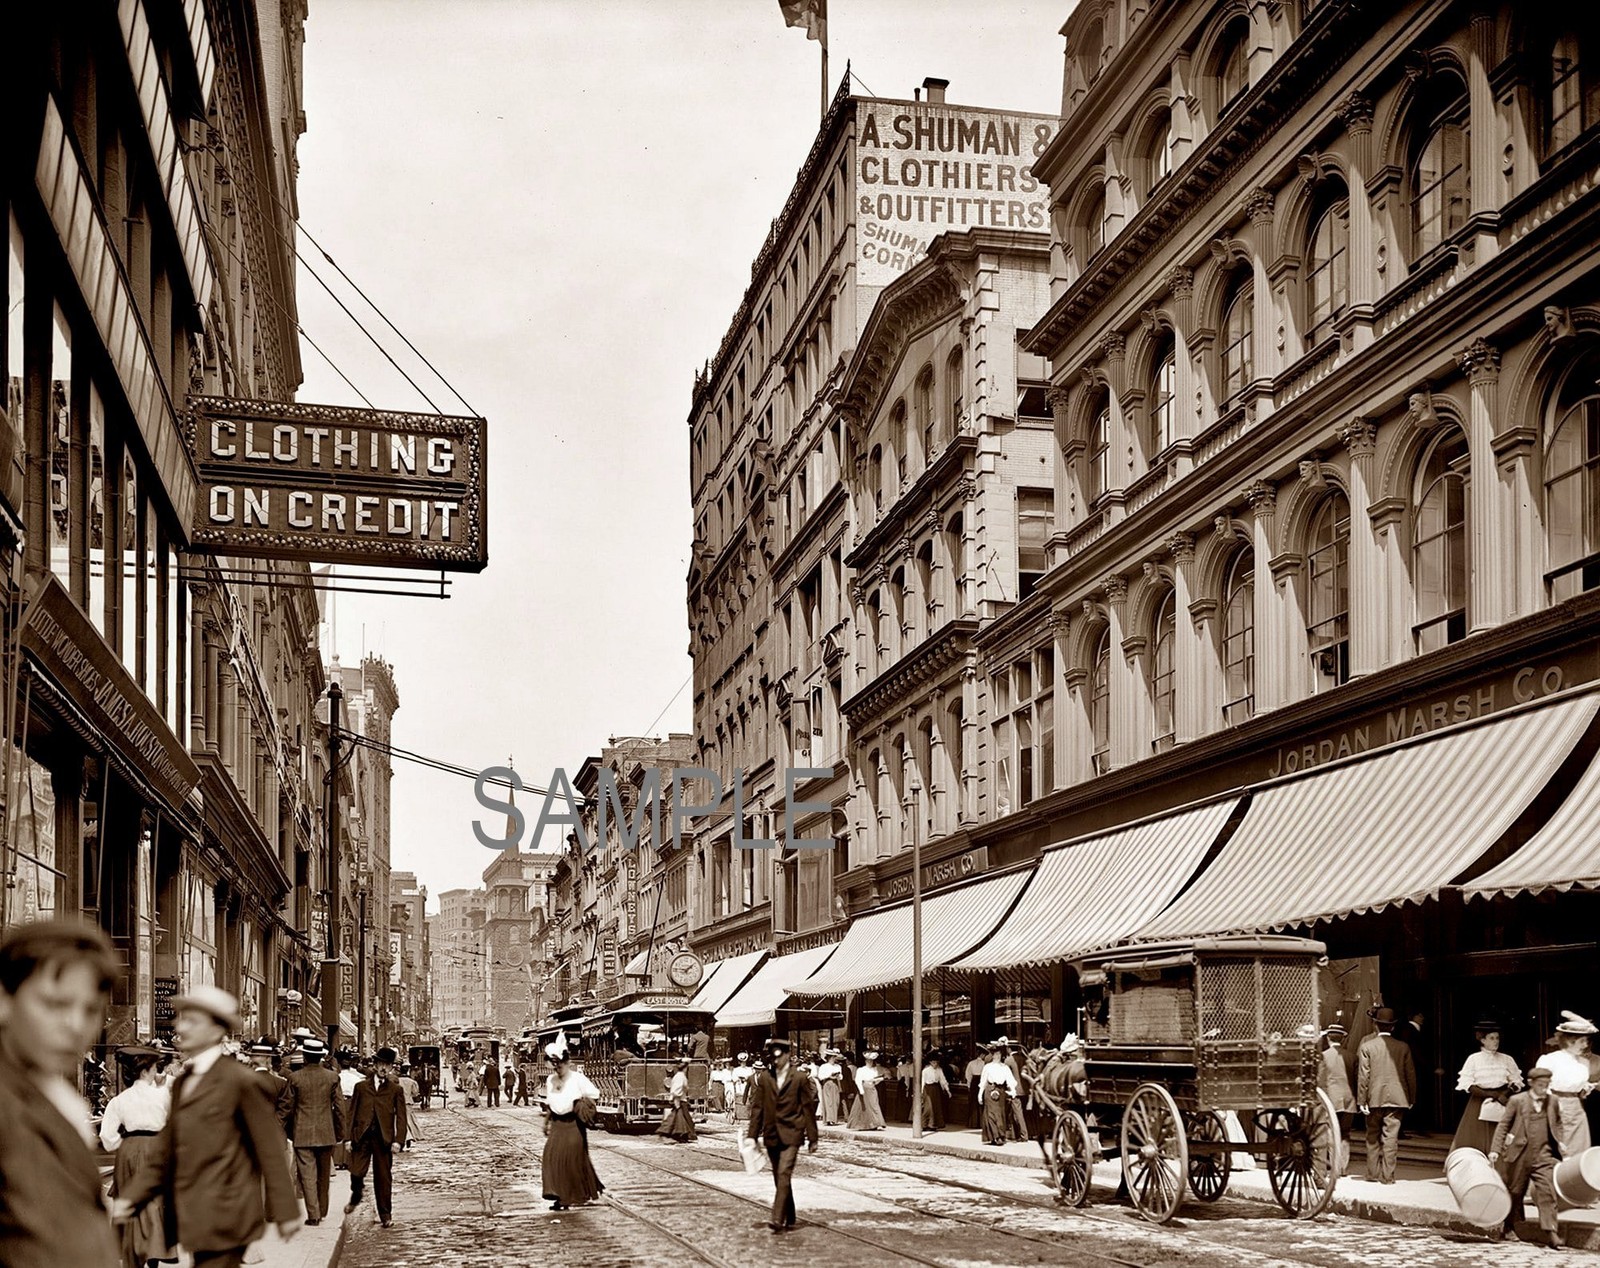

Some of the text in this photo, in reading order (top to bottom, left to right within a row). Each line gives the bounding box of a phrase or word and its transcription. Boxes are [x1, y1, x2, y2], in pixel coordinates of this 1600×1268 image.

[861, 156, 1038, 193] CLOTHIERS
[210, 420, 455, 474] CLOTHING
[209, 485, 458, 538] ON CREDIT
[28, 605, 59, 643] LITTLE
[51, 628, 83, 672] WONDER
[75, 658, 102, 692] SHOES
[94, 677, 133, 727] JAMES
[129, 719, 169, 770] HOUSTON
[1268, 725, 1370, 779] JORDAN
[1385, 684, 1496, 742] MARSH
[887, 875, 915, 898] JORDA
[925, 860, 957, 888] MARSH
[343, 926, 353, 1004] DIAONDS
